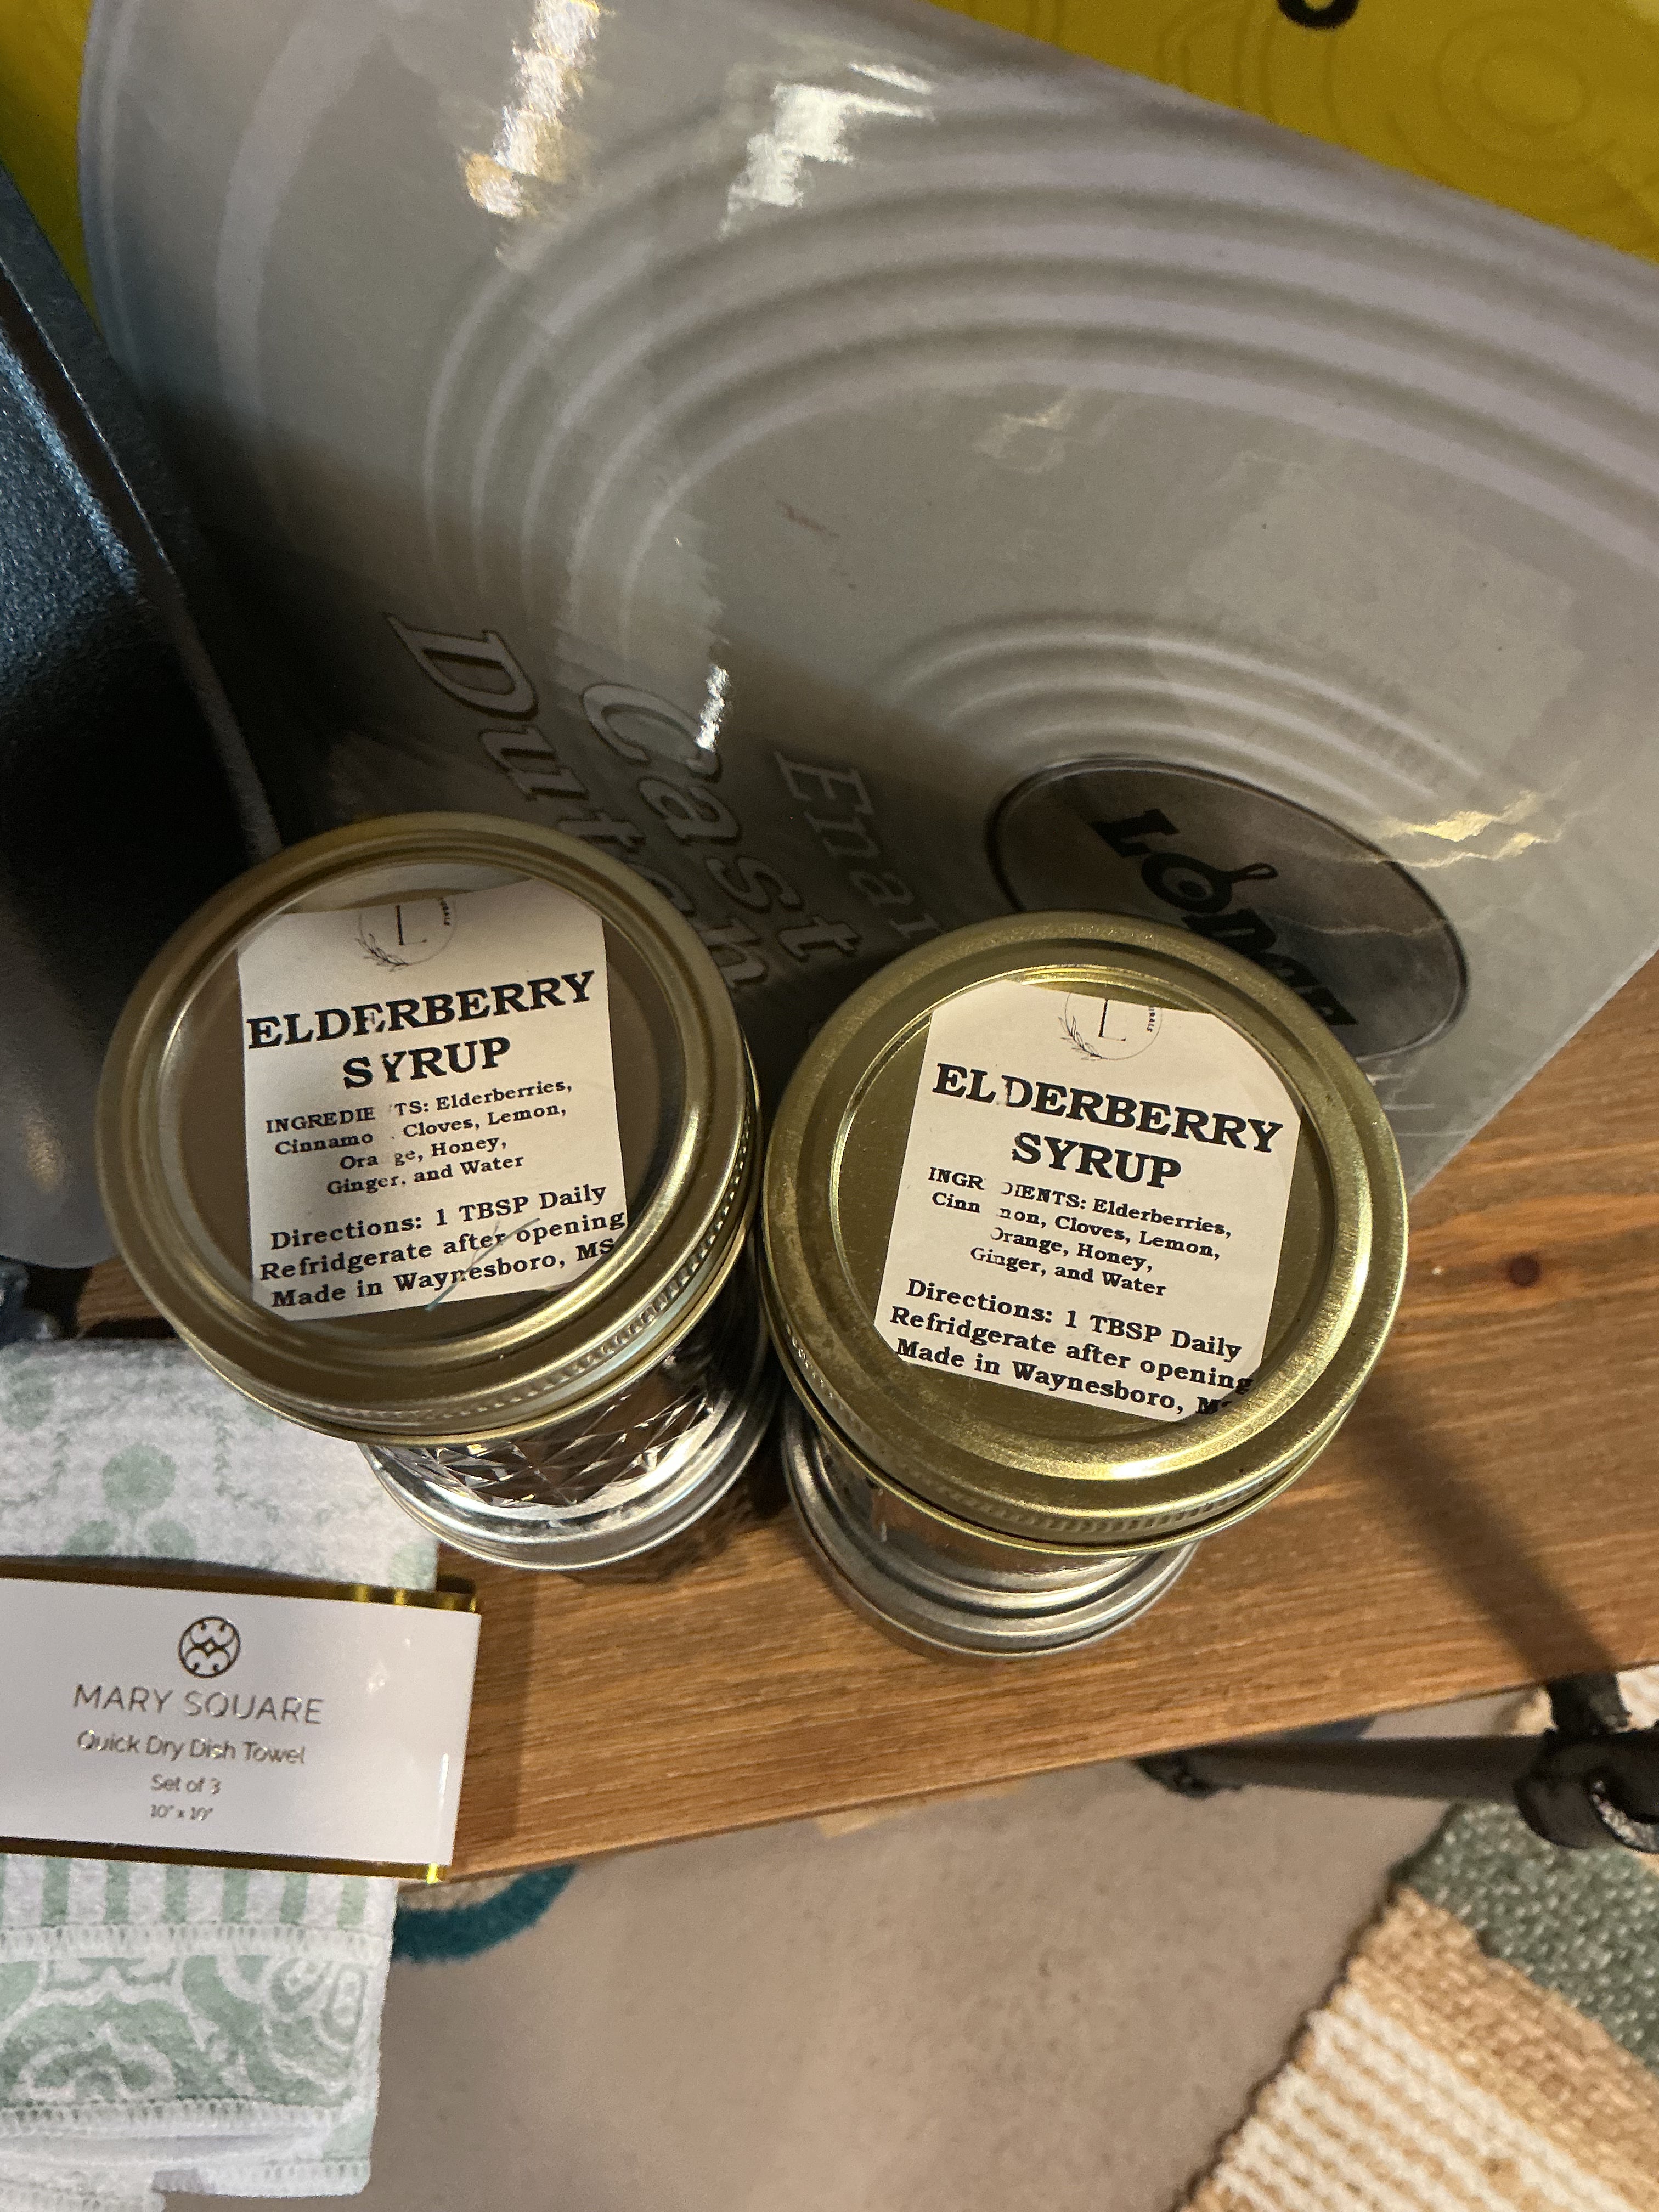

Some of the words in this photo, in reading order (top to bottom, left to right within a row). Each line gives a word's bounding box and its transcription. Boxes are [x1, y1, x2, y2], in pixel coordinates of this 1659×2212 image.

[582, 682, 863, 962] Cast
[246, 970, 596, 1049] ELDERBERRY
[343, 1036, 511, 1090] SYRUP
[266, 1101, 429, 1134] INGREDIETS:
[436, 1081, 572, 1111] Elderberries,
[403, 1118, 479, 1137] Cloves,
[487, 1104, 566, 1125] Lemon,
[932, 1062, 1283, 1153] ELDERBERRY
[340, 1149, 424, 1170] Orage,
[431, 1137, 507, 1157] Honey,
[414, 1164, 454, 1182] and
[460, 1156, 524, 1175] Water
[1012, 1132, 1181, 1189] SYRUP
[269, 1216, 422, 1250] Directions:
[437, 1208, 448, 1226] 1
[459, 1196, 529, 1222] TBSP
[539, 1184, 607, 1210] Daily
[928, 1167, 1087, 1210] INGRDIENTS:
[1092, 1198, 1232, 1239] Elderberries,
[259, 1243, 432, 1281] Refridgerate
[443, 1232, 506, 1255] after
[517, 1212, 625, 1245] opening
[1054, 1215, 1131, 1245] Cloves,
[1138, 1231, 1220, 1261] Lemon,
[1076, 1242, 1152, 1272] Honey,
[272, 1284, 346, 1307] Made
[357, 1280, 383, 1297] in
[393, 1255, 565, 1291] Waynesboro,
[970, 1246, 1046, 1277] Ginger,
[1054, 1266, 1094, 1283] and
[1101, 1271, 1166, 1296] Water
[906, 1278, 1052, 1323] Directions:
[1065, 1310, 1077, 1328] 1
[1090, 1314, 1162, 1343] TBSP
[1170, 1329, 1242, 1363] Daily
[889, 1306, 1056, 1354] Refridgerate
[1066, 1342, 1131, 1369] after
[1140, 1360, 1254, 1395] opening
[895, 1338, 965, 1367] Made
[974, 1353, 1000, 1375] in
[1012, 1360, 1183, 1415] Waynesboro,
[1195, 1395, 1233, 1415] M
[73, 1684, 173, 1714] MARY
[184, 1689, 325, 1725] SQUARE
[77, 1729, 140, 1754] Quick
[146, 1735, 184, 1762] Dry
[190, 1737, 236, 1761] Dish
[242, 1741, 306, 1765] Towel
[150, 1774, 182, 1791] Set
[186, 1776, 206, 1792] of
[210, 1778, 222, 1795] 3
